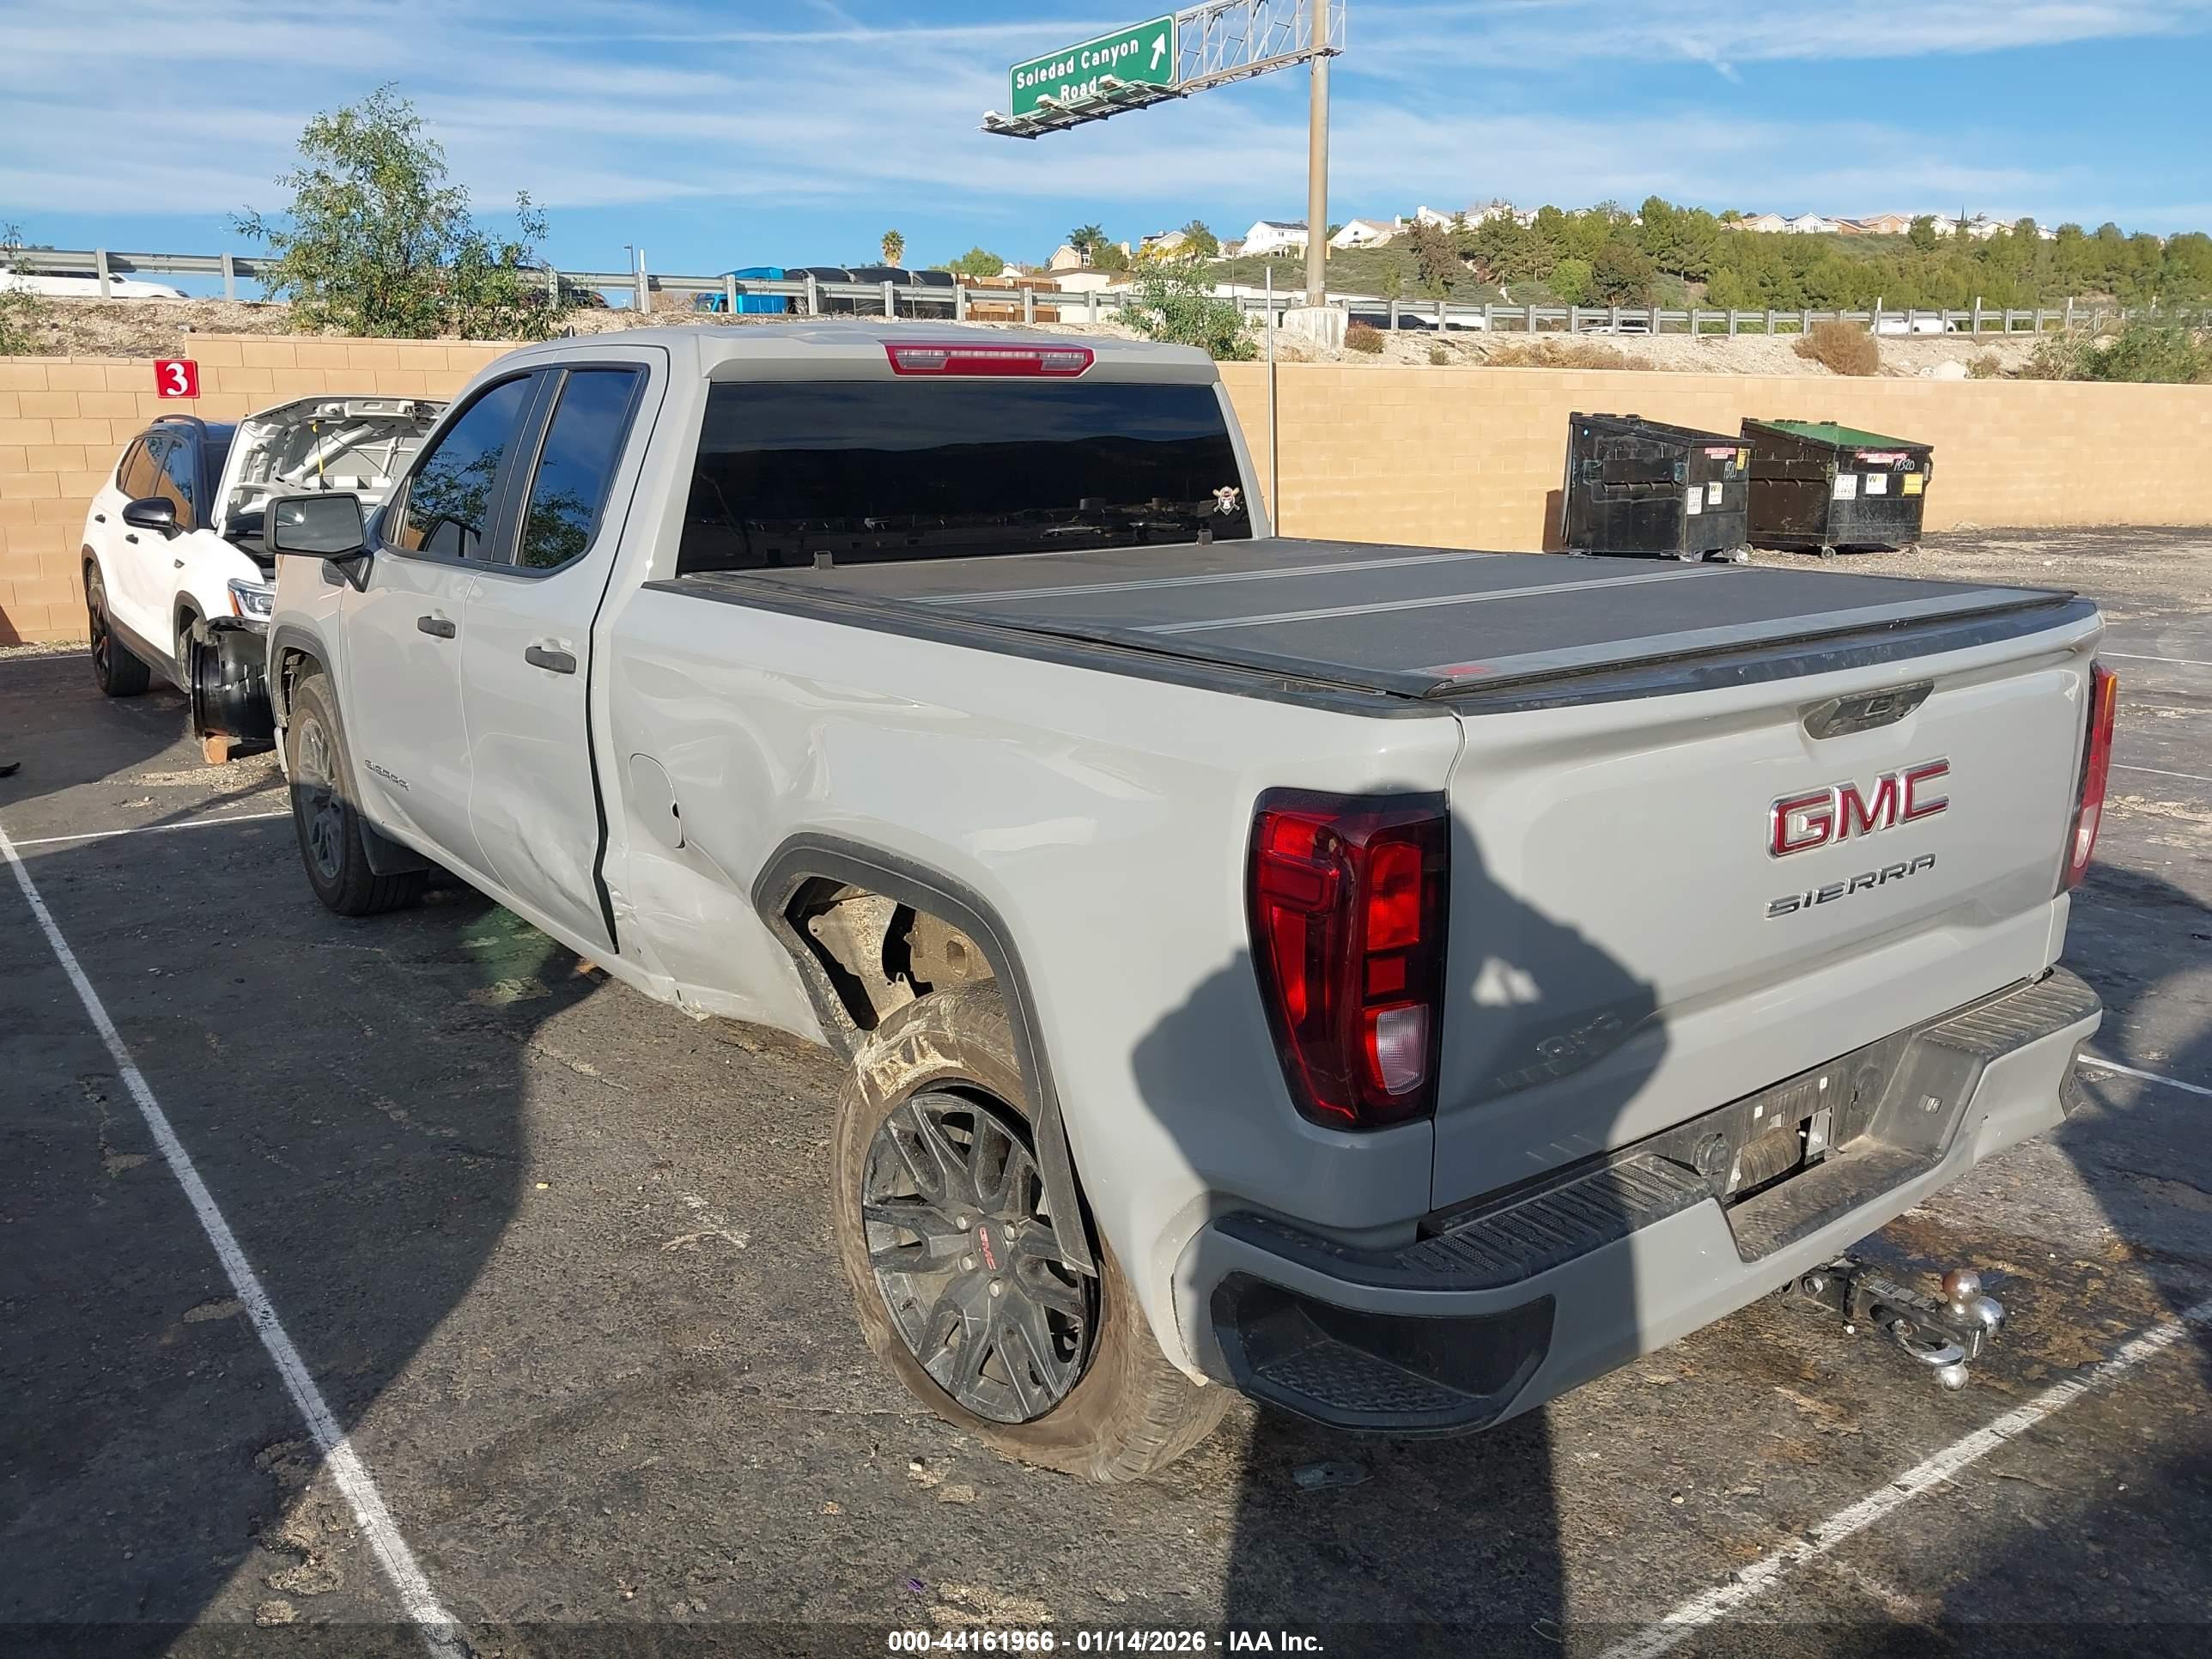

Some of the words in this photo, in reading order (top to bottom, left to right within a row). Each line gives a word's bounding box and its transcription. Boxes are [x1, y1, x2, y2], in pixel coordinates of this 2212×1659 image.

[1017, 56, 1074, 89] Soledad
[1081, 40, 1139, 69] Canyon
[1060, 76, 1097, 102] Road
[165, 362, 188, 396] 3
[364, 759, 410, 792] SIERRA
[1765, 757, 1951, 860] GMC
[1765, 853, 1936, 920] SIERRA
[979, 1227, 997, 1270] GMC
